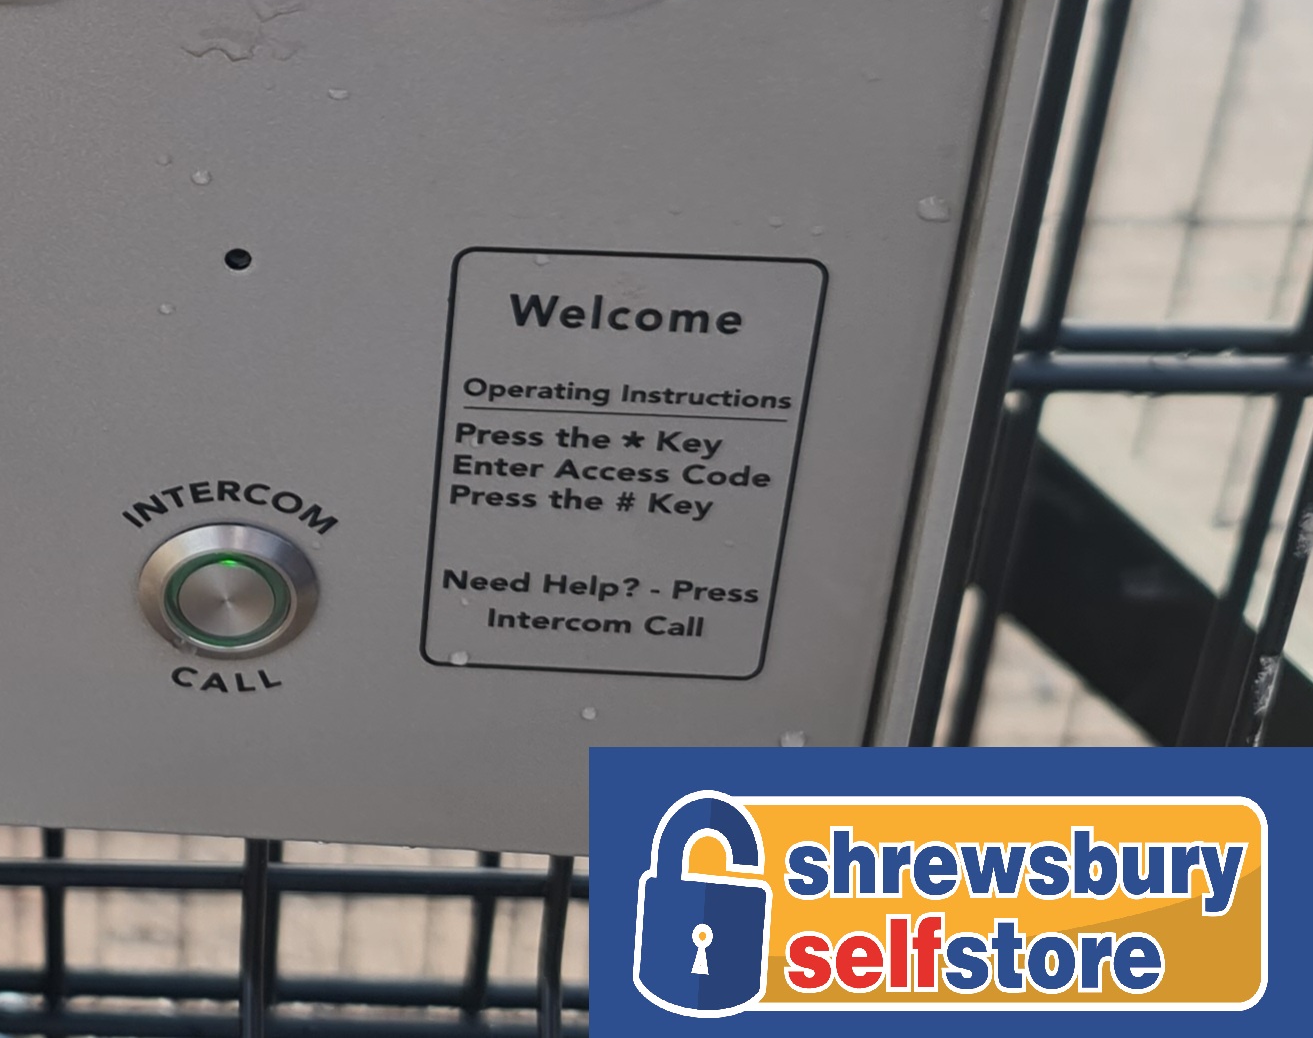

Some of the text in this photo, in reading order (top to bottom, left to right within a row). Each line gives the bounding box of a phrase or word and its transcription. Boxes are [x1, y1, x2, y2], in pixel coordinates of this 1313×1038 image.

[510, 293, 743, 335] Welcome
[463, 377, 792, 409] Operating Instructions
[455, 422, 544, 447] Press
[555, 426, 611, 449] the
[656, 431, 723, 460] Key
[452, 454, 771, 488] Enter Access Code
[122, 480, 339, 535] INTERCOM
[449, 484, 537, 509] Press
[549, 488, 603, 511] the
[647, 493, 714, 522] Key
[442, 569, 531, 593] Need
[543, 573, 639, 602] Help?
[672, 579, 759, 604] Press
[487, 608, 704, 637] Intercom Call
[171, 666, 282, 693] CALL
